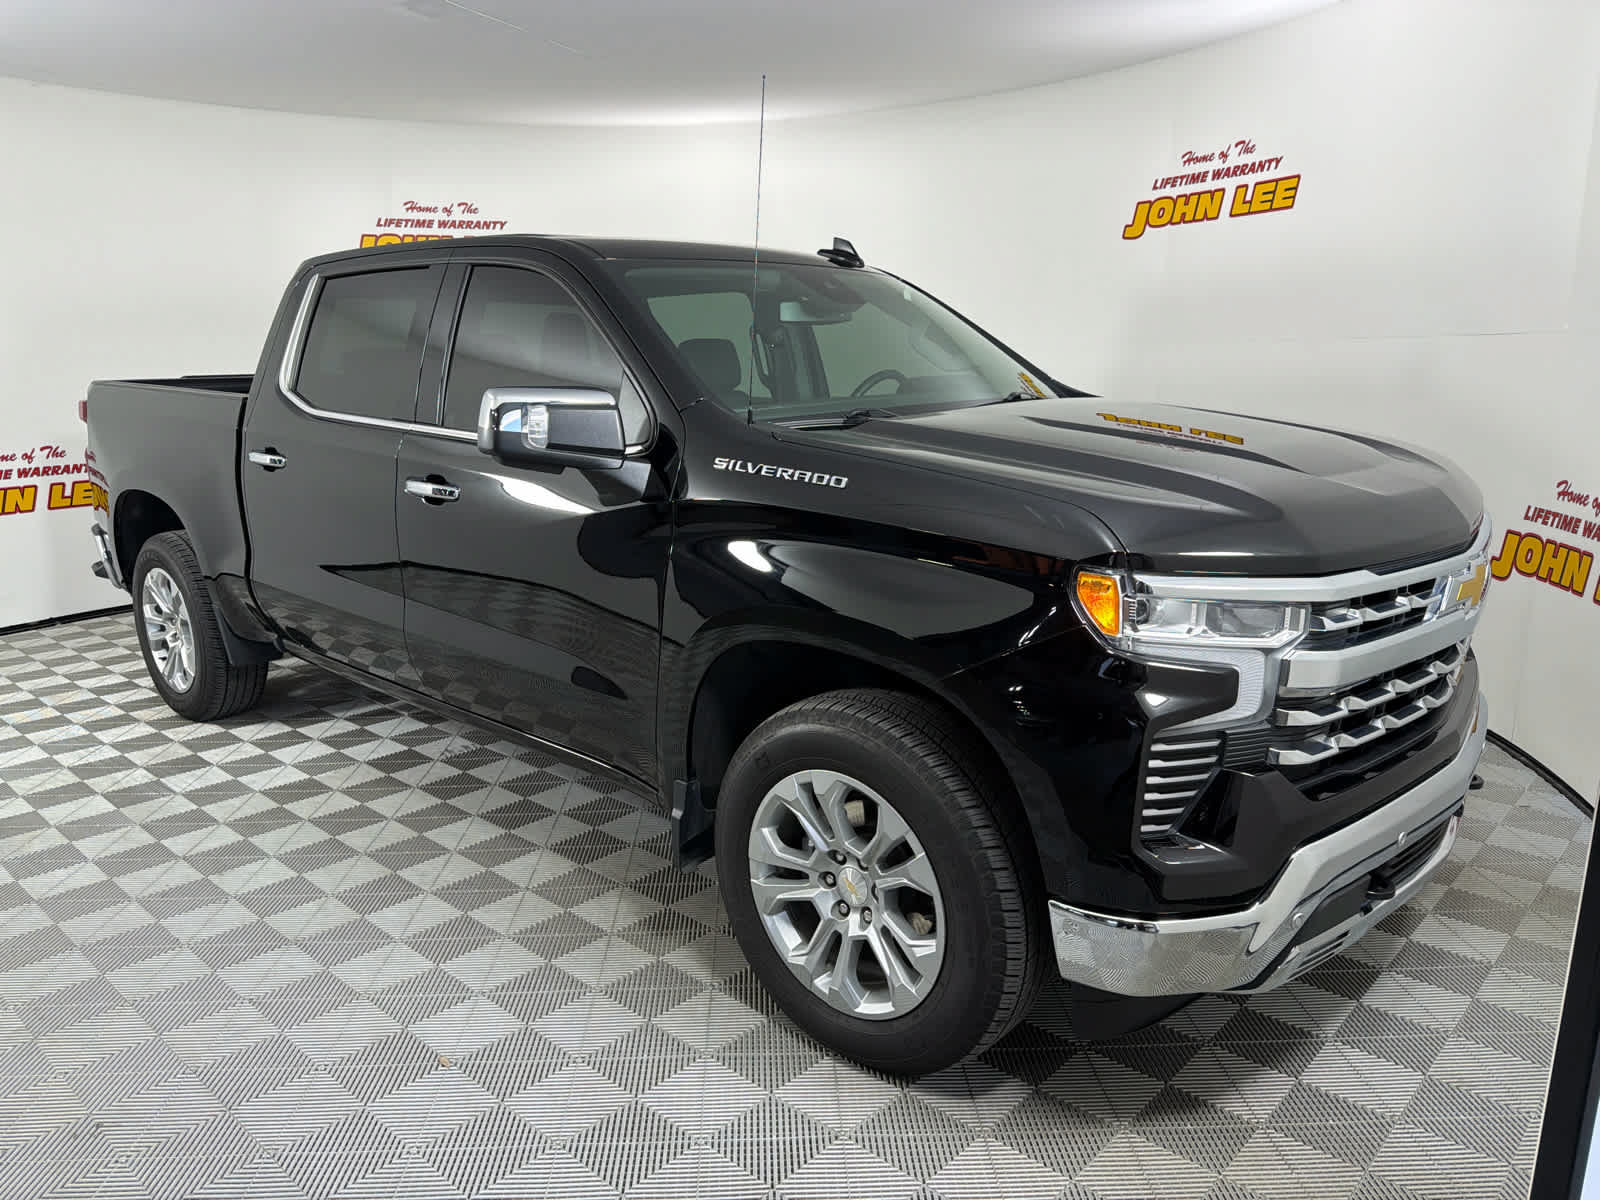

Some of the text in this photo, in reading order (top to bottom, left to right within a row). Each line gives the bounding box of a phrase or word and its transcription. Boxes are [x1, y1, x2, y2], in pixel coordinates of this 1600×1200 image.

[1181, 139, 1256, 166] Home of The
[1152, 156, 1283, 191] LIFETIME WARRANTY
[403, 200, 479, 217] Home of The
[1122, 174, 1301, 240] JOHN LEE
[376, 218, 507, 231] LIFETIME WARRANTY
[21, 448, 35, 464] of
[40, 446, 67, 460] The
[17, 463, 88, 480] WARRANT
[713, 457, 848, 489] SILVERADO
[48, 480, 93, 511] LE
[1556, 480, 1590, 507] Home
[1524, 505, 1582, 535] LIFETIME
[1490, 529, 1594, 598] JOHN
